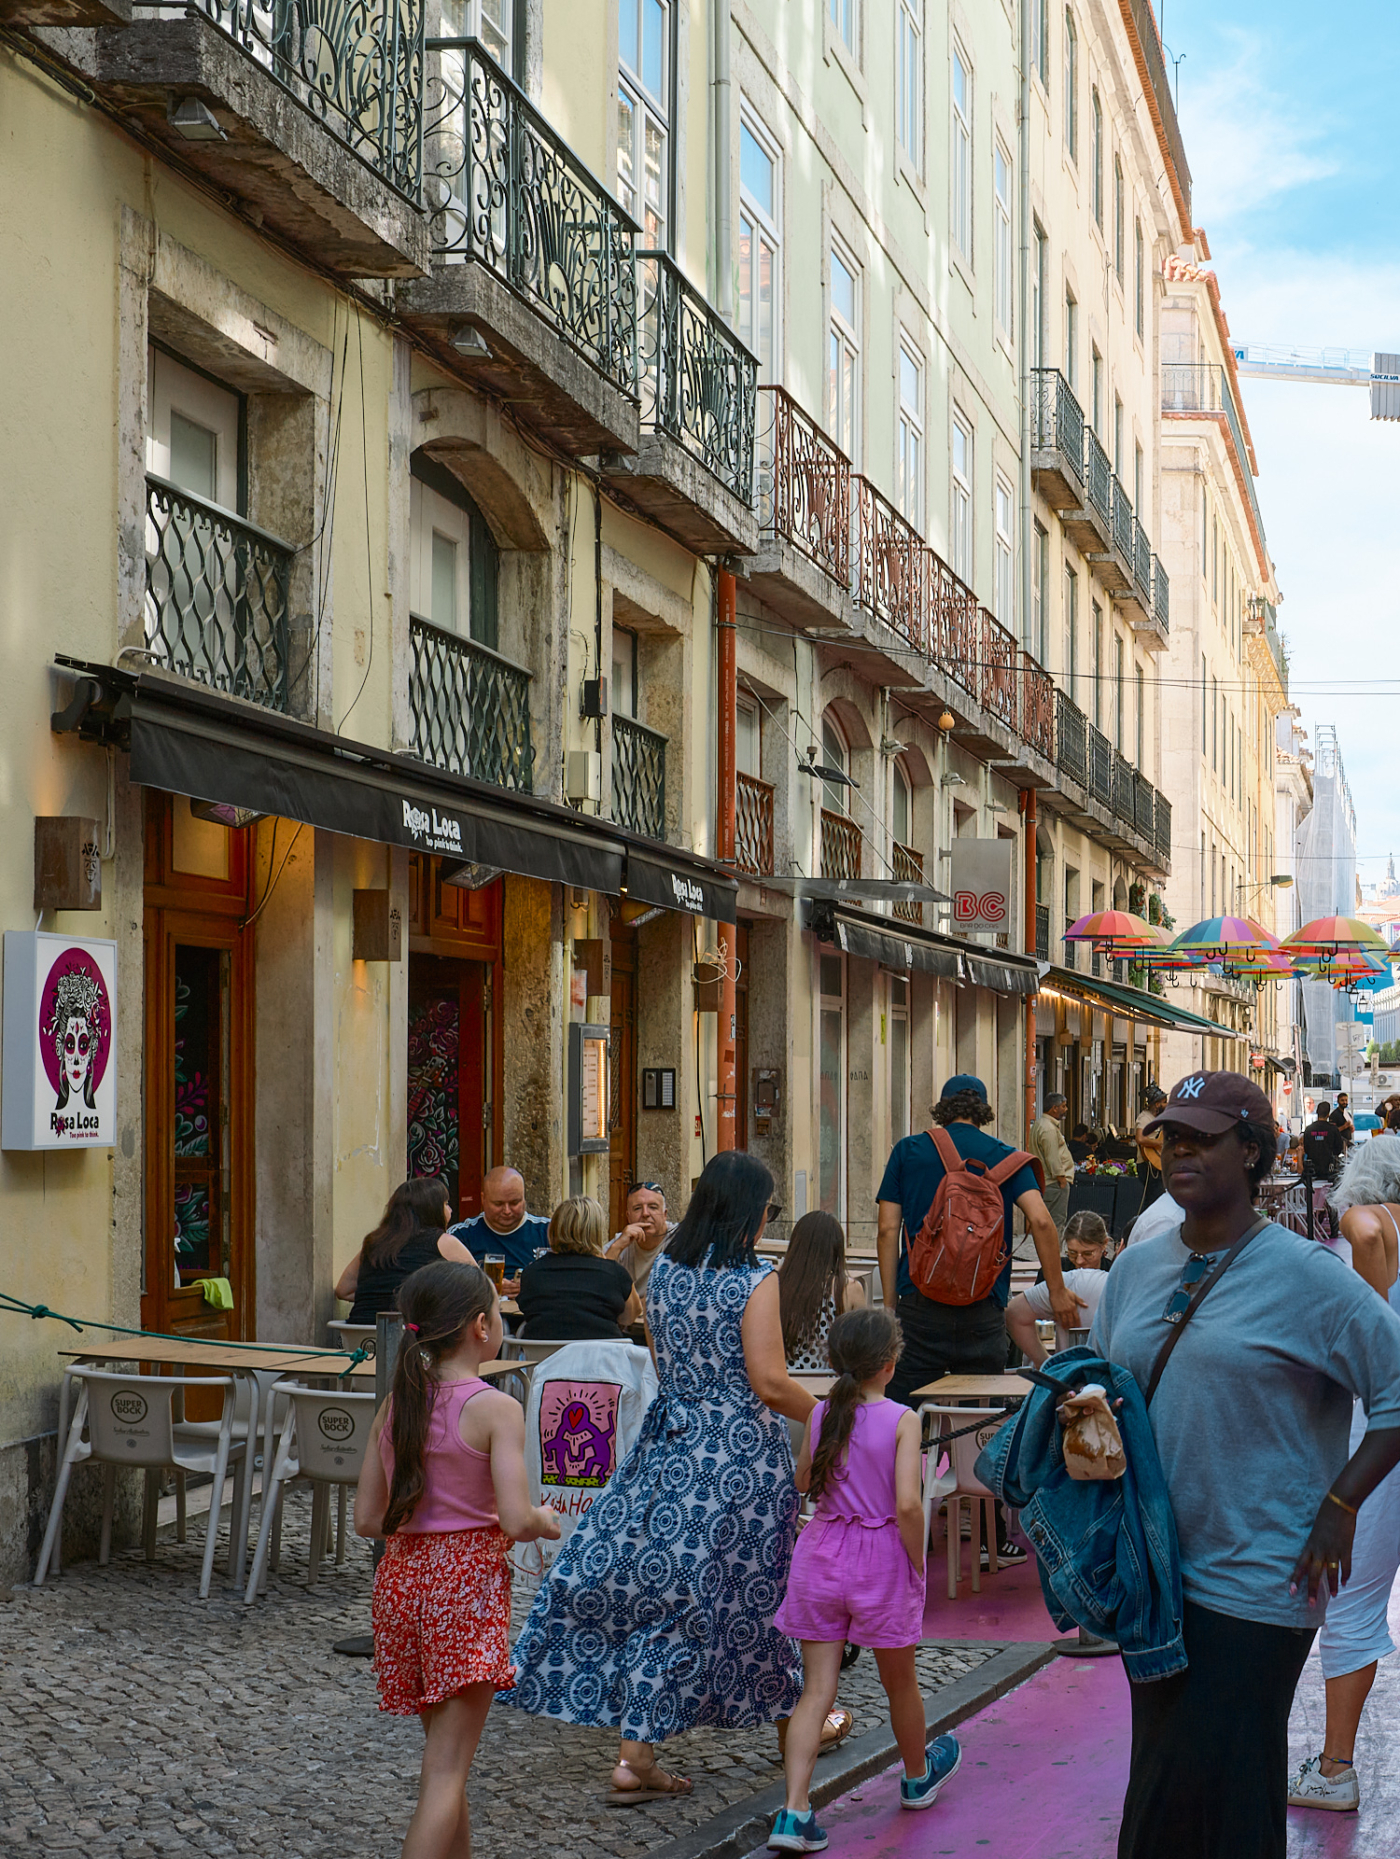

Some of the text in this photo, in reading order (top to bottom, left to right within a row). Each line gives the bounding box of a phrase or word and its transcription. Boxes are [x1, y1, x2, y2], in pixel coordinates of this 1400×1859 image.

[431, 808, 461, 840] Loca
[954, 891, 1005, 922] BC
[1177, 1076, 1206, 1098] NY
[77, 1112, 99, 1129] Loca
[115, 1399, 142, 1408] SUPER
[117, 1406, 142, 1415] BOCK
[322, 1415, 349, 1425] SUPER
[324, 1423, 349, 1432] BOCK
